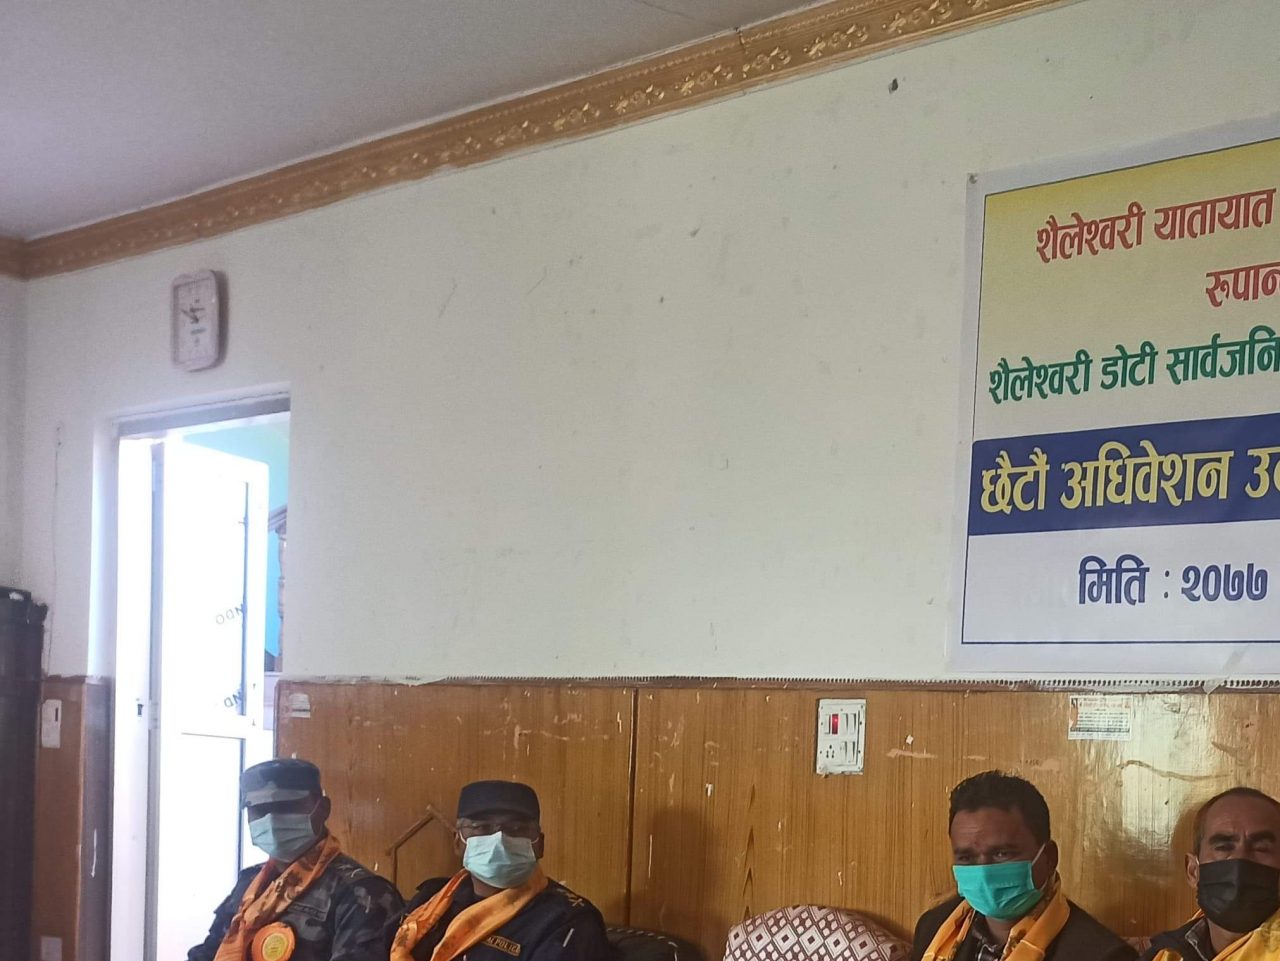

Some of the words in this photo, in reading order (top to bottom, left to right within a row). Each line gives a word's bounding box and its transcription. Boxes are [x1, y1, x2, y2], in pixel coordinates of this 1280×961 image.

[1036, 201, 1146, 263] शैलेश्वरी
[1154, 188, 1277, 241] यातायात
[988, 349, 1093, 404] शैलेश्वरी
[1100, 340, 1159, 390] डोटी
[1060, 439, 1234, 511] अधिवेशन
[1079, 554, 1150, 606] मिति
[1181, 562, 1268, 602] २०७७
